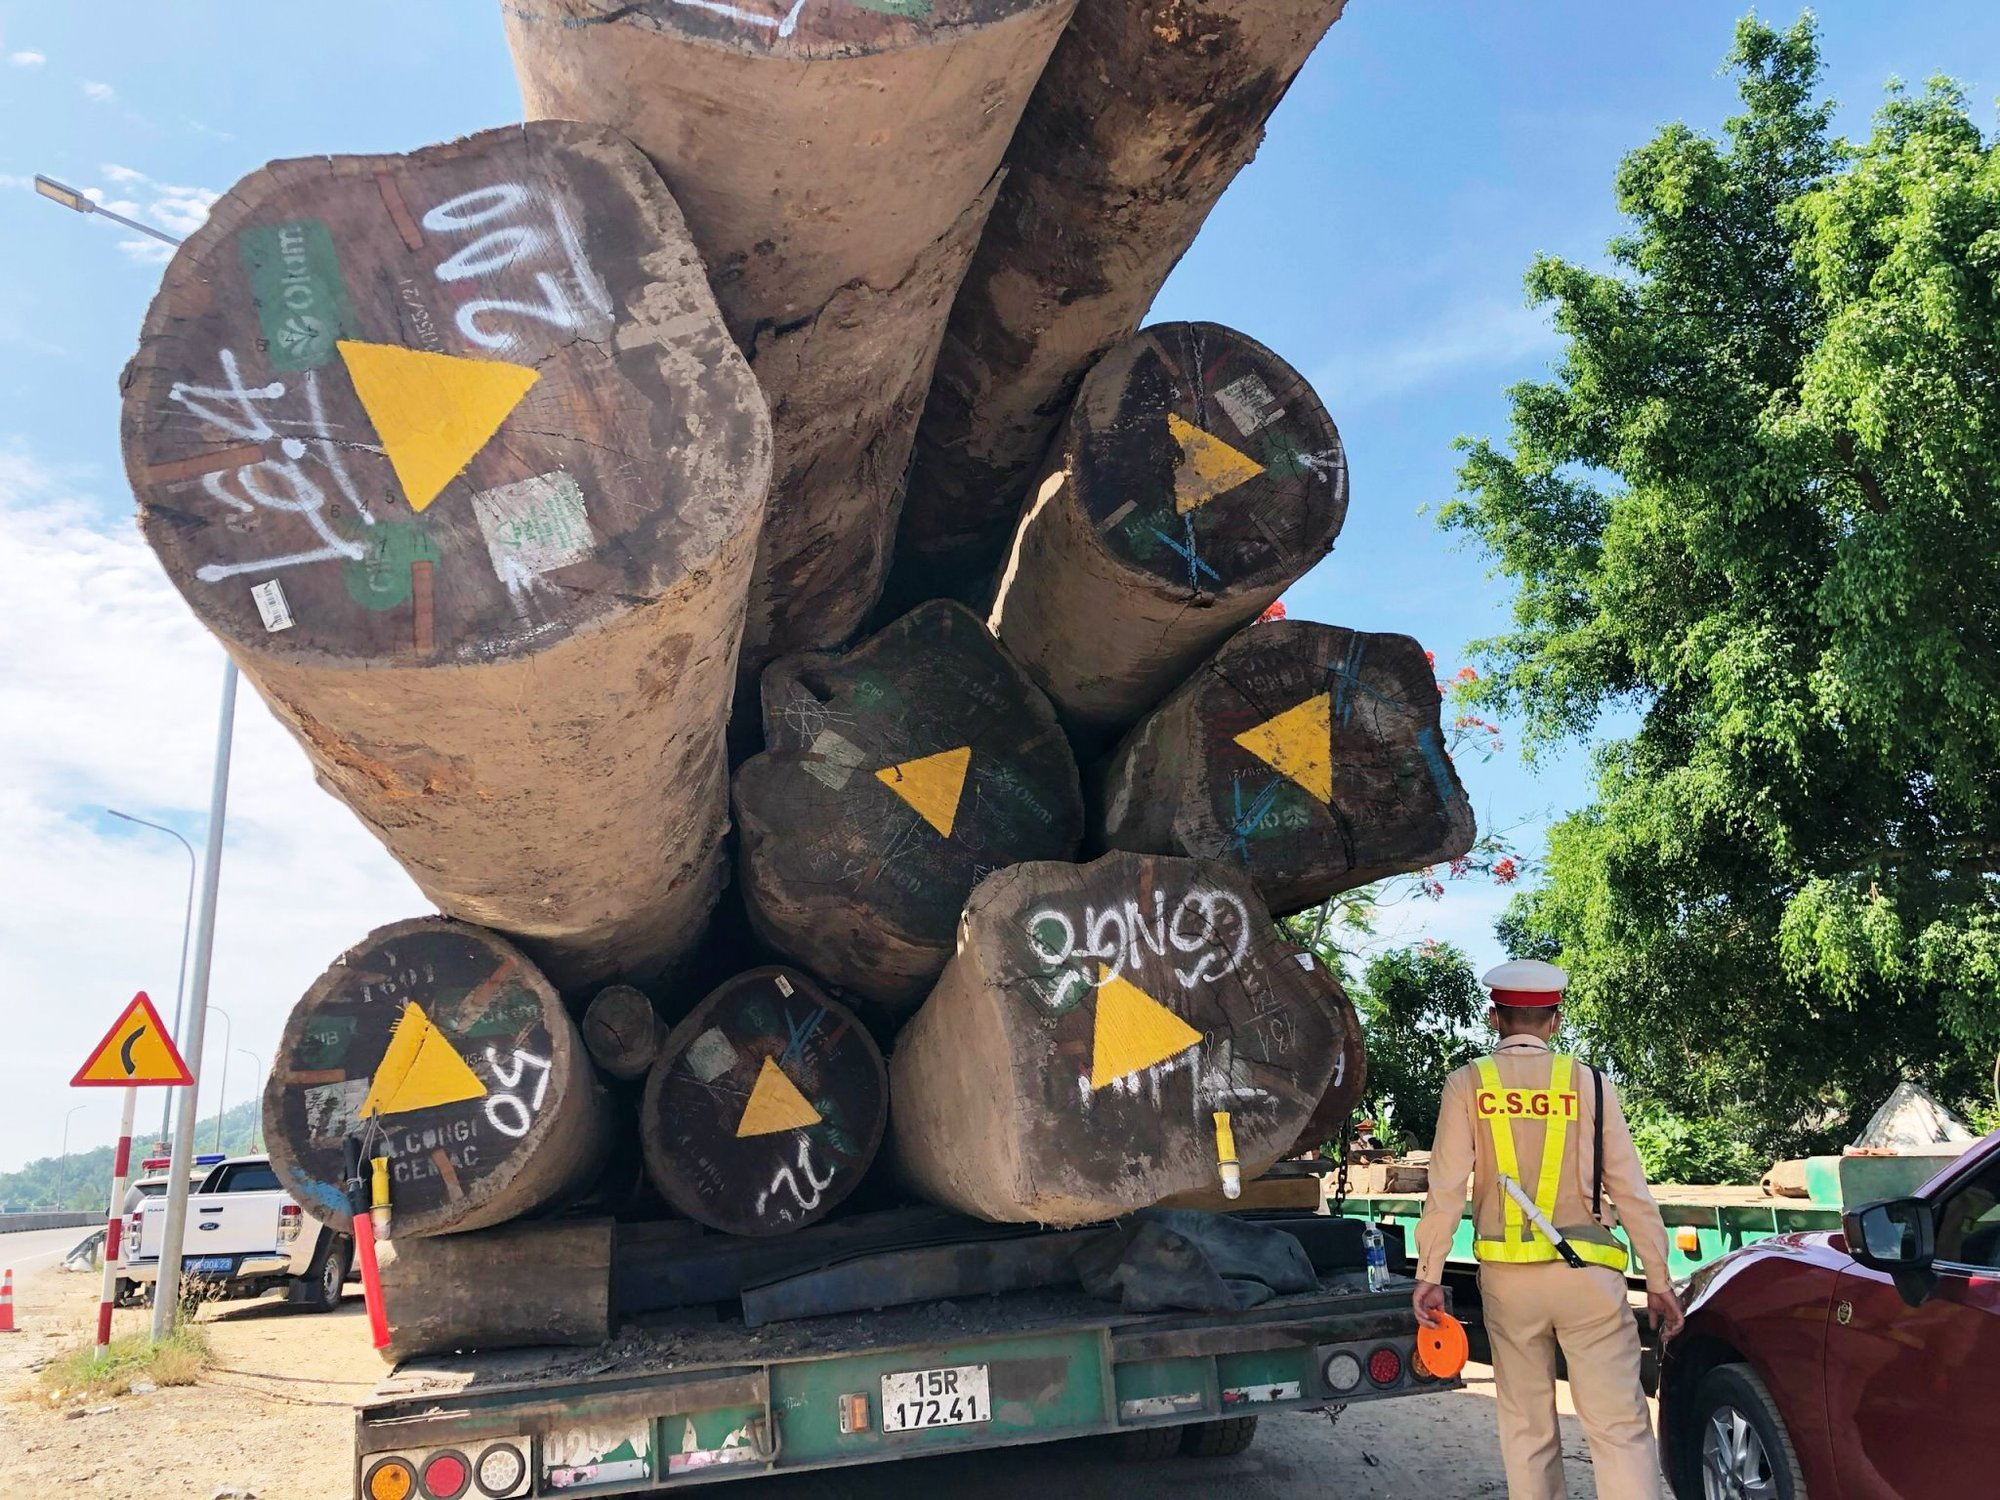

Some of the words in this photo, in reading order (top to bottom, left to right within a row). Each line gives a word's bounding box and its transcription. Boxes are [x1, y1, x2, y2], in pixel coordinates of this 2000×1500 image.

[422, 182, 577, 350] 200
[1478, 1092, 1577, 1117] C.S.G.T
[915, 1370, 958, 1397] 15R
[897, 1395, 977, 1427] 172.41
